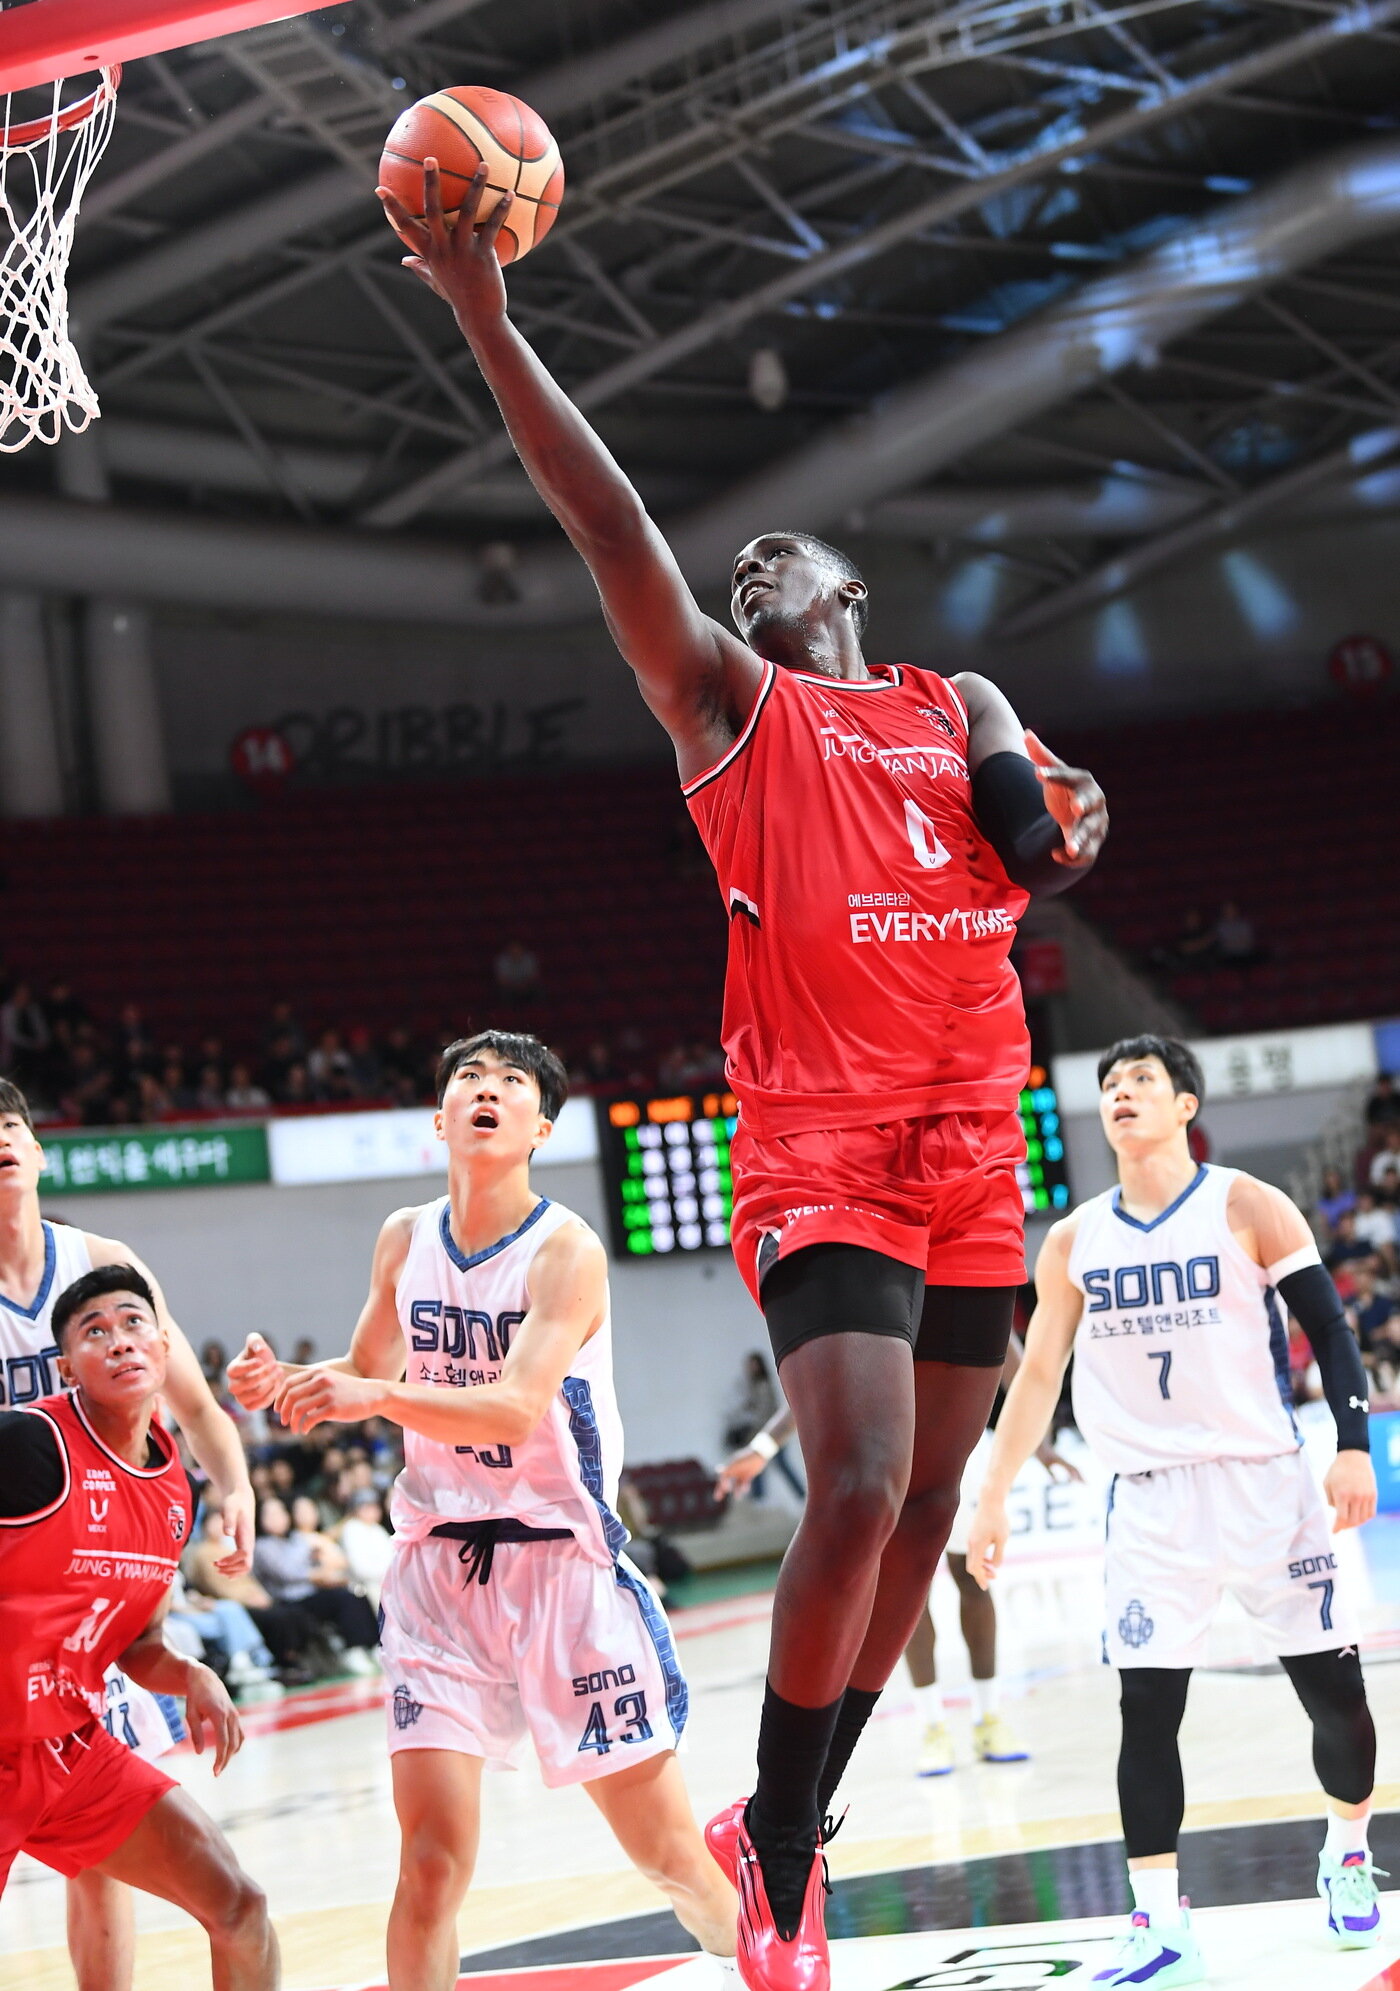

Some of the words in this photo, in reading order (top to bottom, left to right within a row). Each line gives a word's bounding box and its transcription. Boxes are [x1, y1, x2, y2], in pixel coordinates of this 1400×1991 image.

[847, 892, 910, 907] 에브리타임
[1090, 1308, 1222, 1339] 소노호텔앤리조트
[1147, 1351, 1171, 1400] 7
[64, 1558, 111, 1577] JUNG
[1307, 1579, 1334, 1631] 7
[578, 1690, 654, 1756] 43
